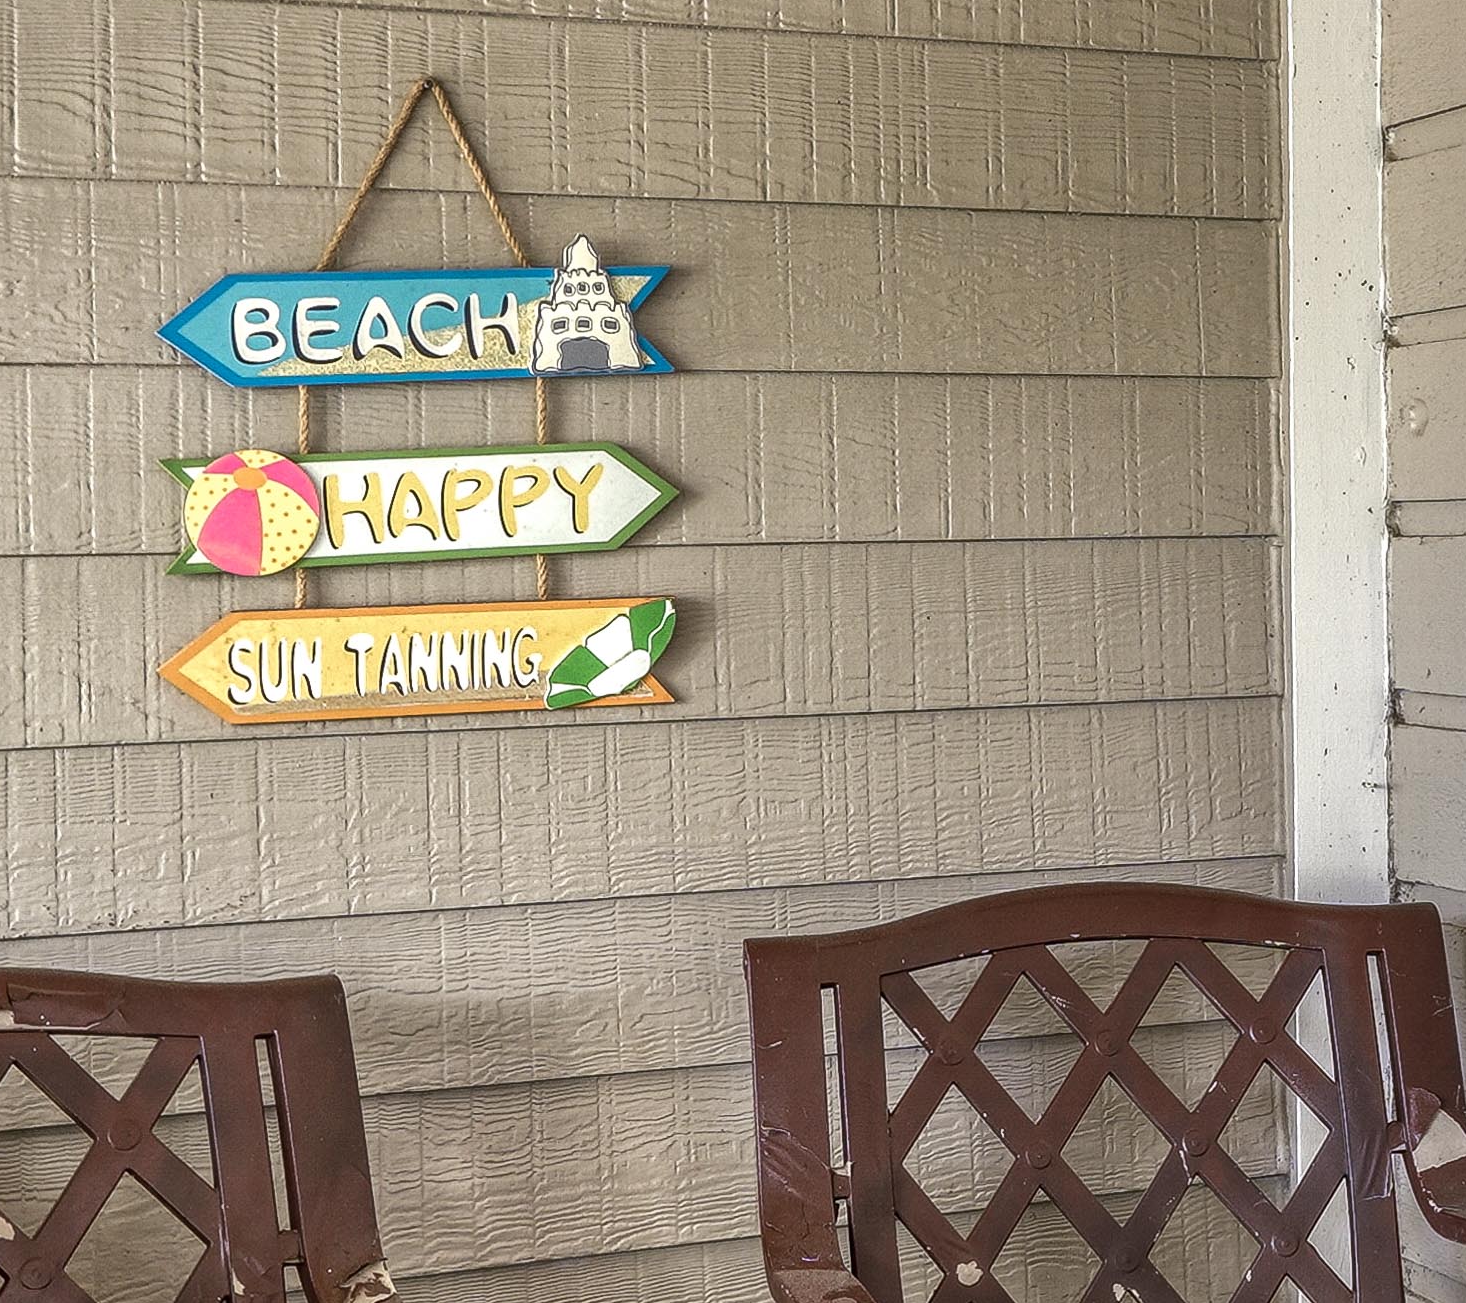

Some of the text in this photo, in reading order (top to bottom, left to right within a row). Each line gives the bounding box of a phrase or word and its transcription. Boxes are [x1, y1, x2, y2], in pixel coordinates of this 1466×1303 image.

[230, 292, 519, 366] BEACH
[324, 463, 605, 550] HAPPY
[227, 626, 543, 706] SUN TANNING
